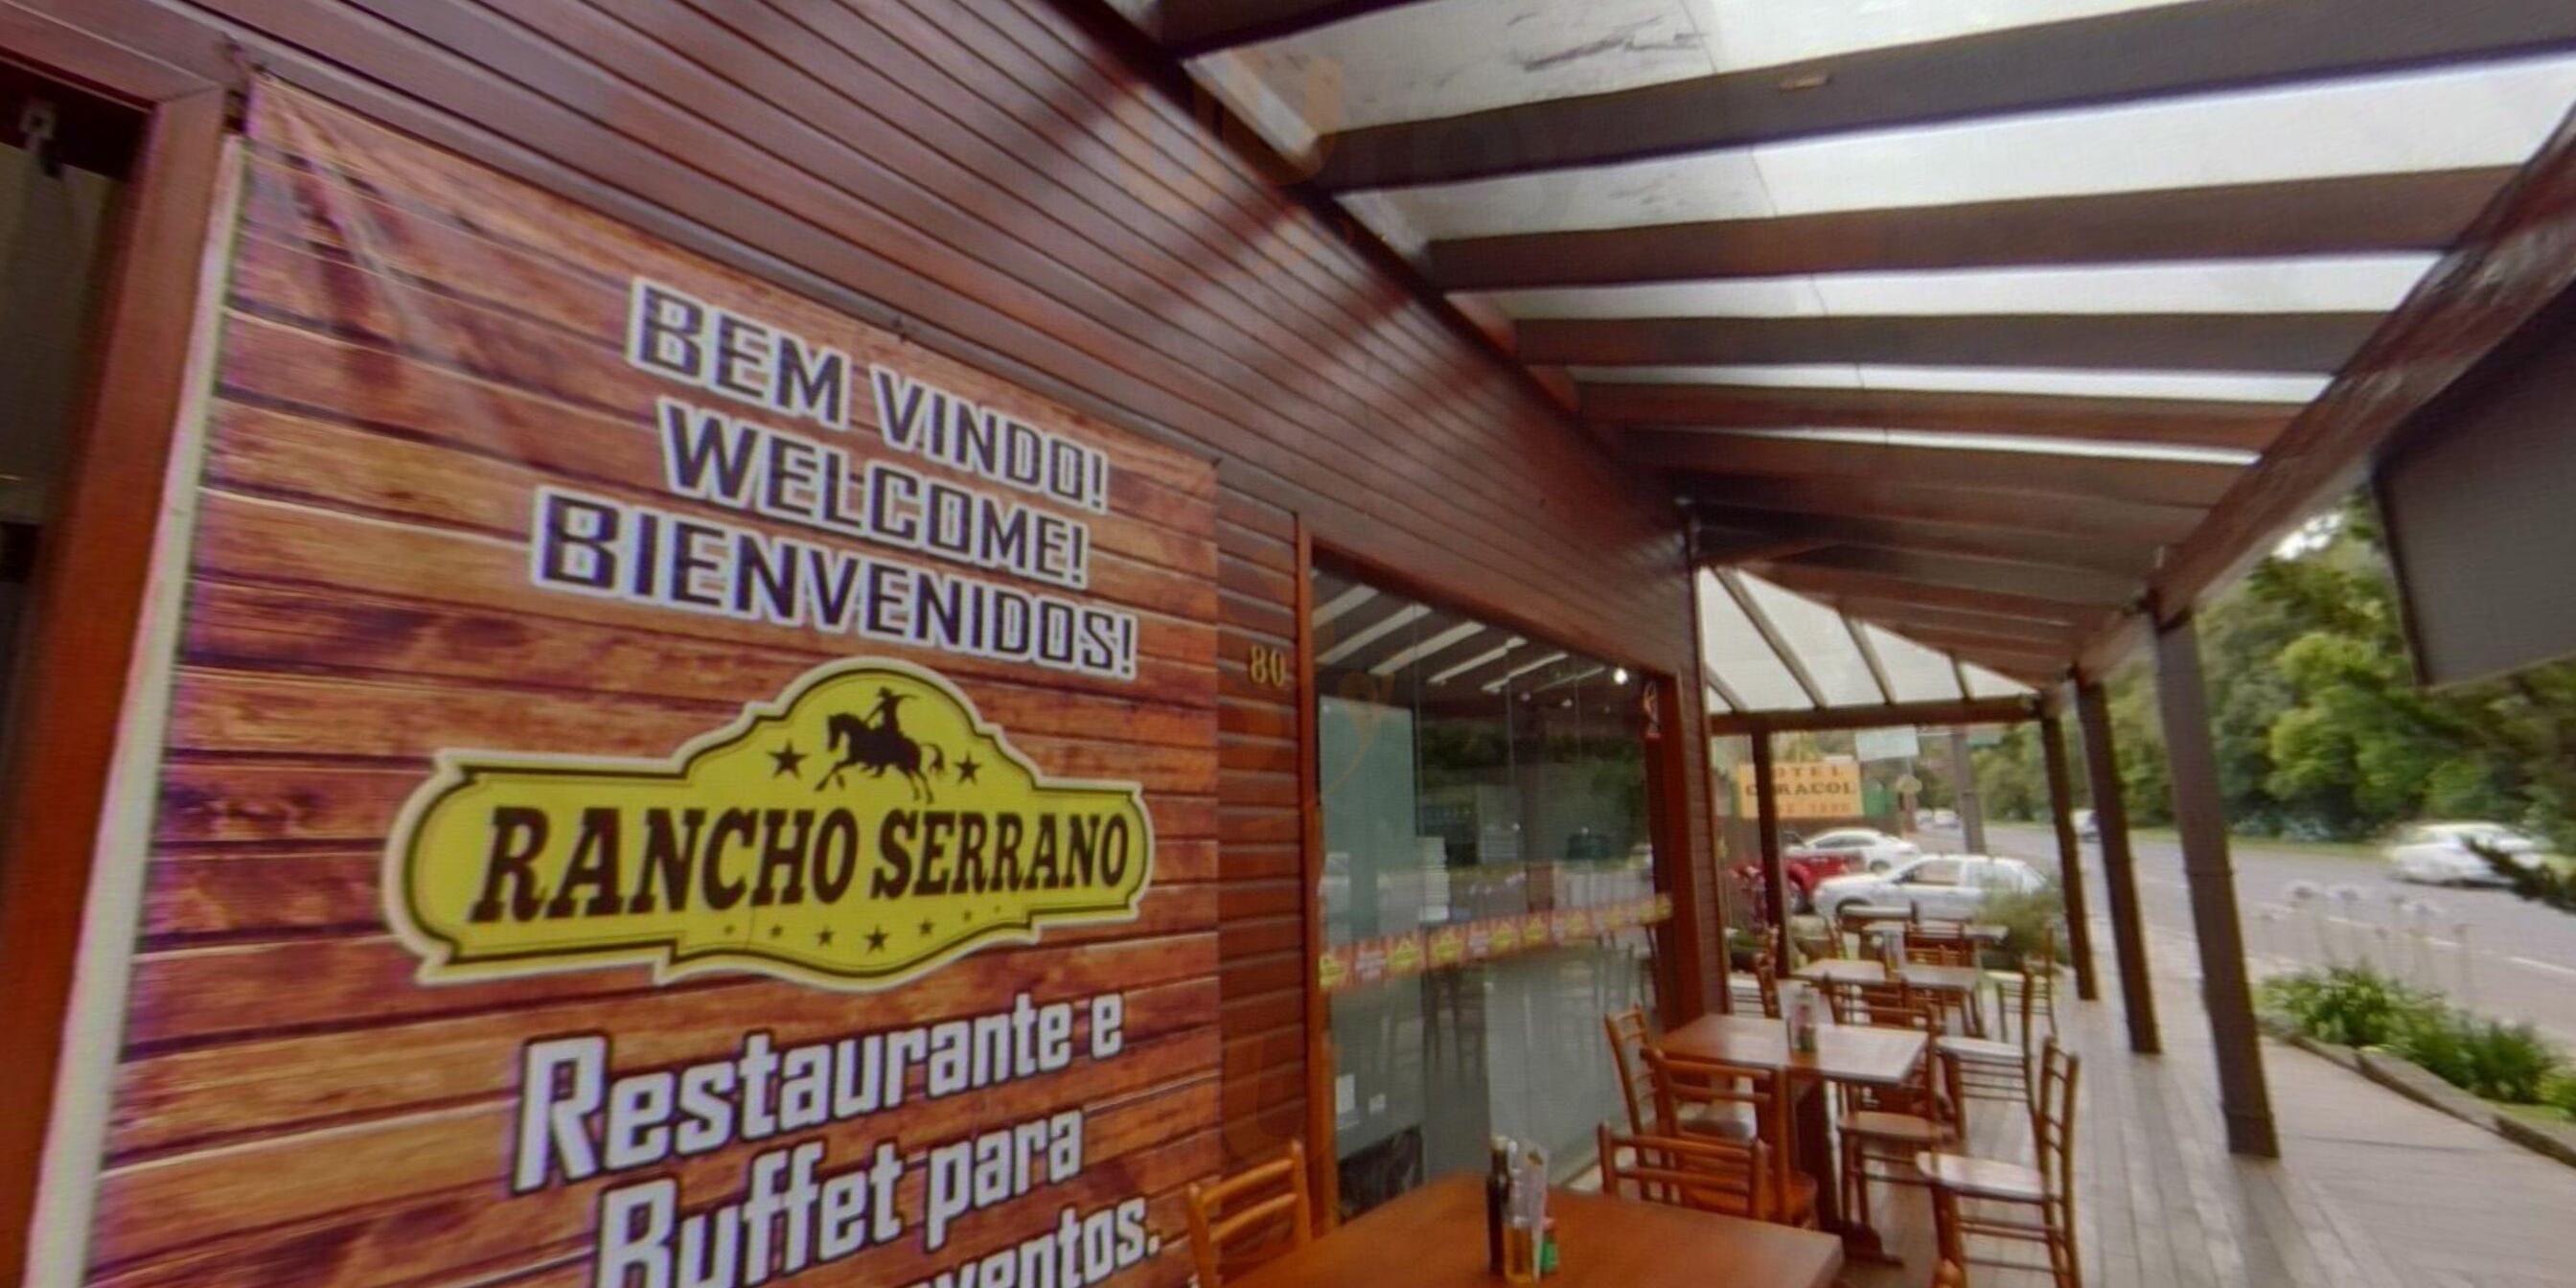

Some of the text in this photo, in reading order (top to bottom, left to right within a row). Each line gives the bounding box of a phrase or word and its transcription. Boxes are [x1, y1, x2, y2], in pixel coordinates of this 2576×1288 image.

[631, 281, 1108, 512] BEM VINDO!
[661, 400, 1087, 587] WELCOME!
[537, 489, 1136, 677] BIENVENIDOS!
[1251, 645, 1285, 687] 80
[1745, 781, 1855, 796] CRACOL
[1761, 766, 1844, 778] OTEL
[468, 805, 1130, 925] RANCHO SERRANO
[512, 991, 1123, 1193] Restaurante e
[594, 1109, 1084, 1288] Buffet para
[907, 1197, 1161, 1288] entos.
